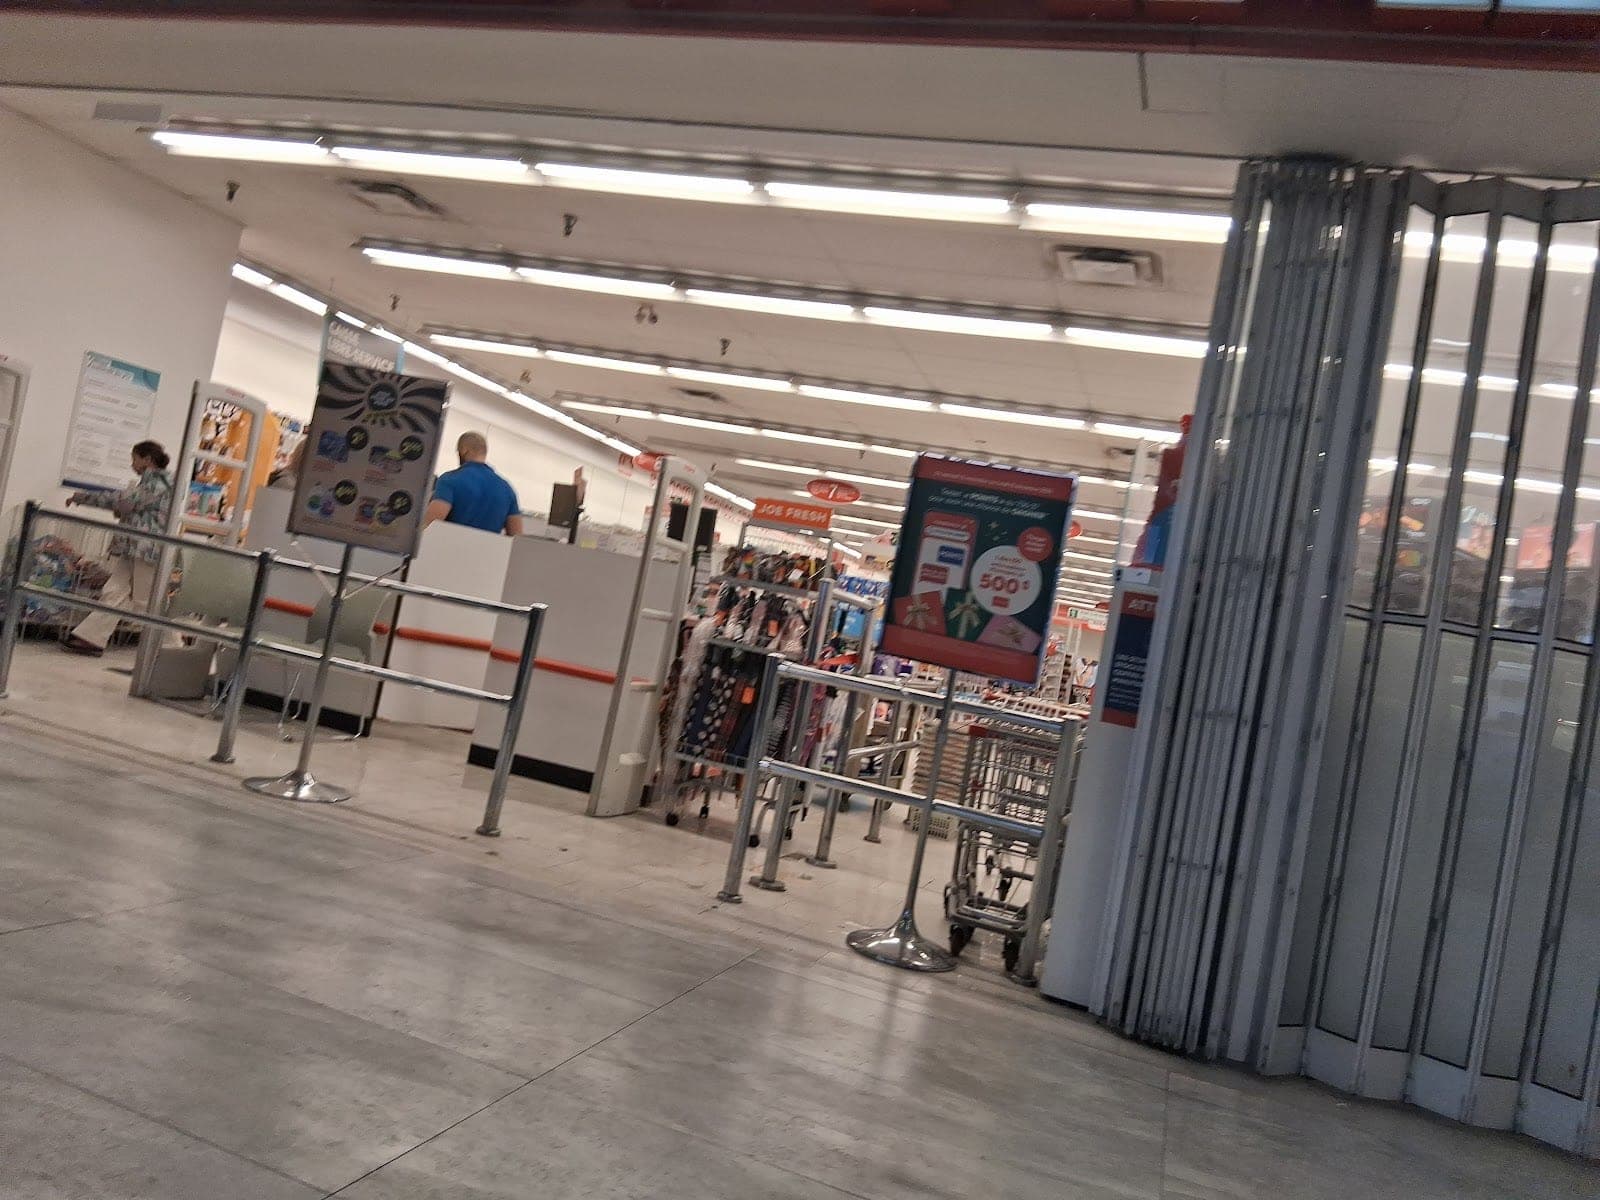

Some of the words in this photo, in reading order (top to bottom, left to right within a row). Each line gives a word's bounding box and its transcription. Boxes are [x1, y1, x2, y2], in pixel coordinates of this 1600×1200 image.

[758, 503, 785, 517] JOE
[785, 507, 828, 523] FRESH
[979, 572, 1020, 594] 500
